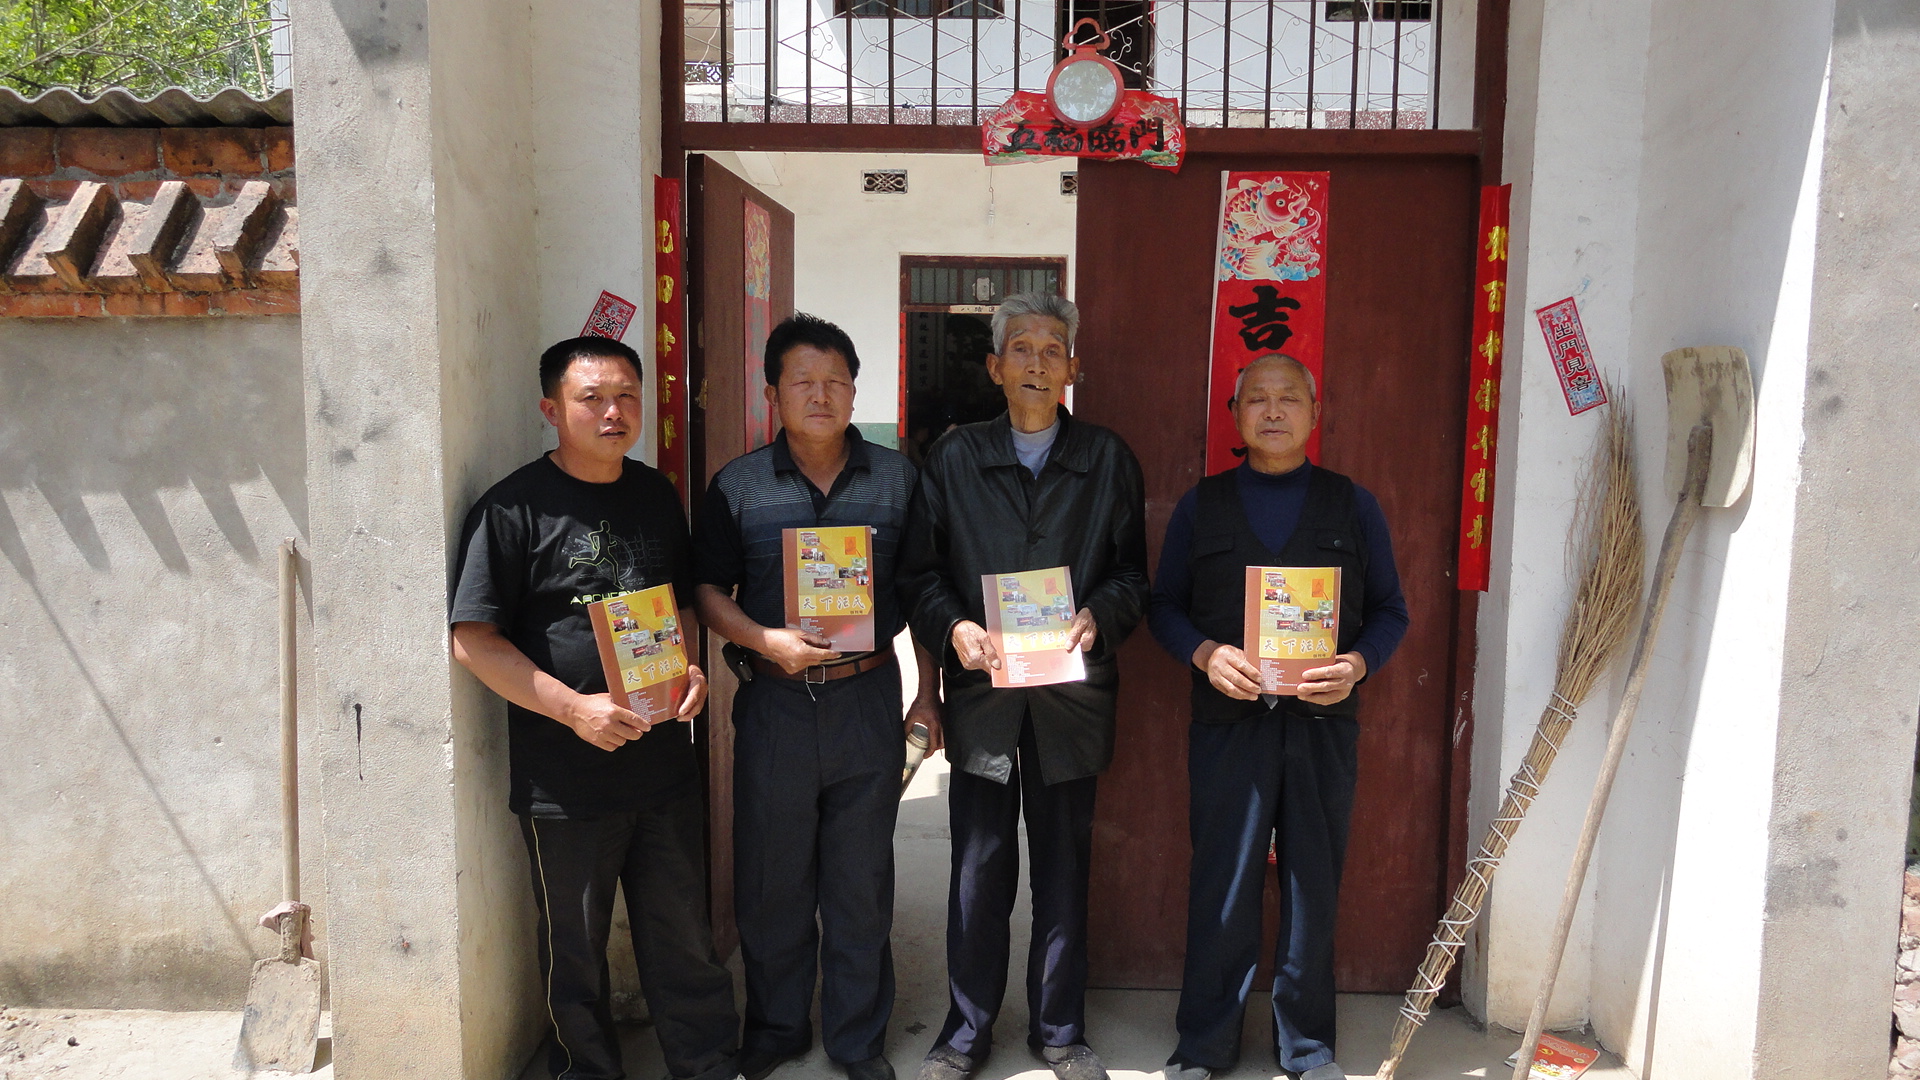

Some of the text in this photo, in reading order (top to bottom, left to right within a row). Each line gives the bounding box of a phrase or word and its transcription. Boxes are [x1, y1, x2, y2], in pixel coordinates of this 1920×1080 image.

[590, 314, 619, 338] 滿
[1554, 322, 1592, 391] 出門見喜
